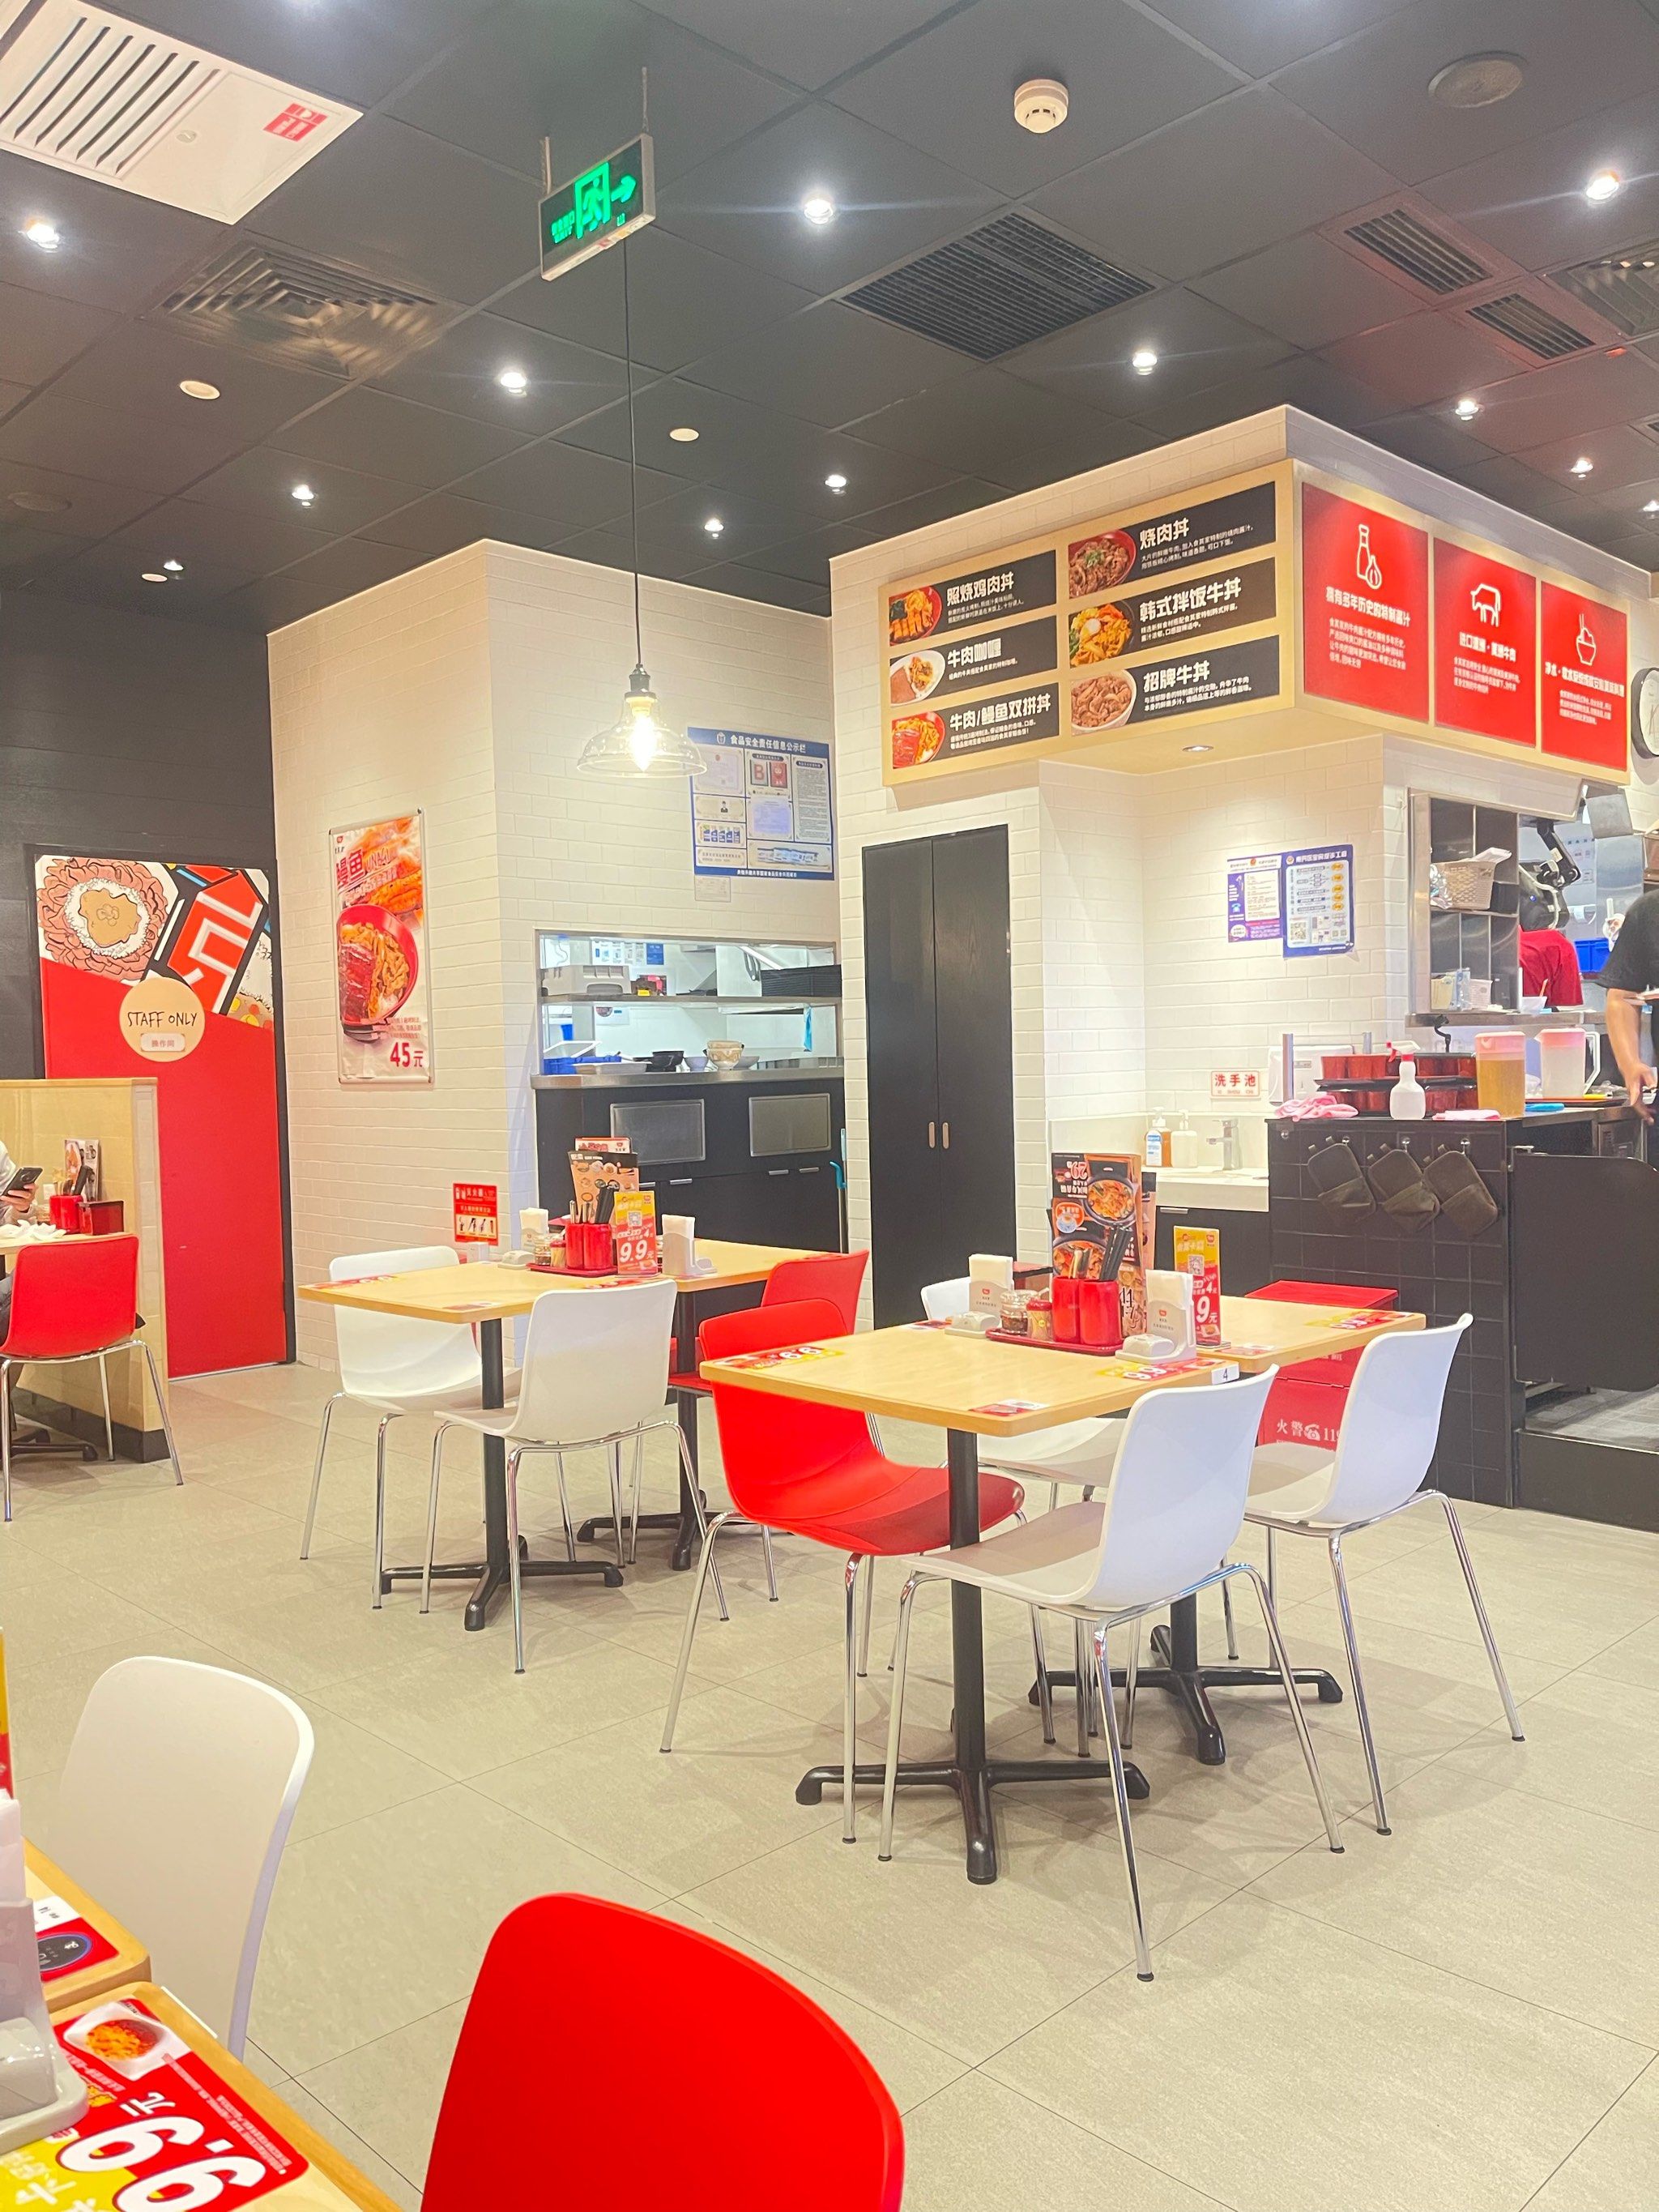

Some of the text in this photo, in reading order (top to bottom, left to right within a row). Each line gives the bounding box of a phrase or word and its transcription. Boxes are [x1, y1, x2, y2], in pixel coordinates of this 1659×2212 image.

[1140, 517, 1189, 550] 烧肉丼
[947, 571, 1014, 606] 照烧鸡肉丼
[1139, 576, 1242, 622] 韩式拌饭牛丼
[947, 638, 1002, 668] 牛肉咖喱
[1143, 660, 1210, 693] 招牌牛丼
[949, 693, 1051, 731] 牛肉/鳗鱼双拼丼
[730, 734, 807, 754] 食品安全责任信息公示栏
[336, 848, 364, 890] 鳗鱼
[128, 1011, 164, 1027] STAFF
[390, 1041, 424, 1068] 45元
[1215, 1074, 1256, 1087] 洗手池
[1222, 1368, 1228, 1381] 4
[1276, 1418, 1303, 1437] 火警
